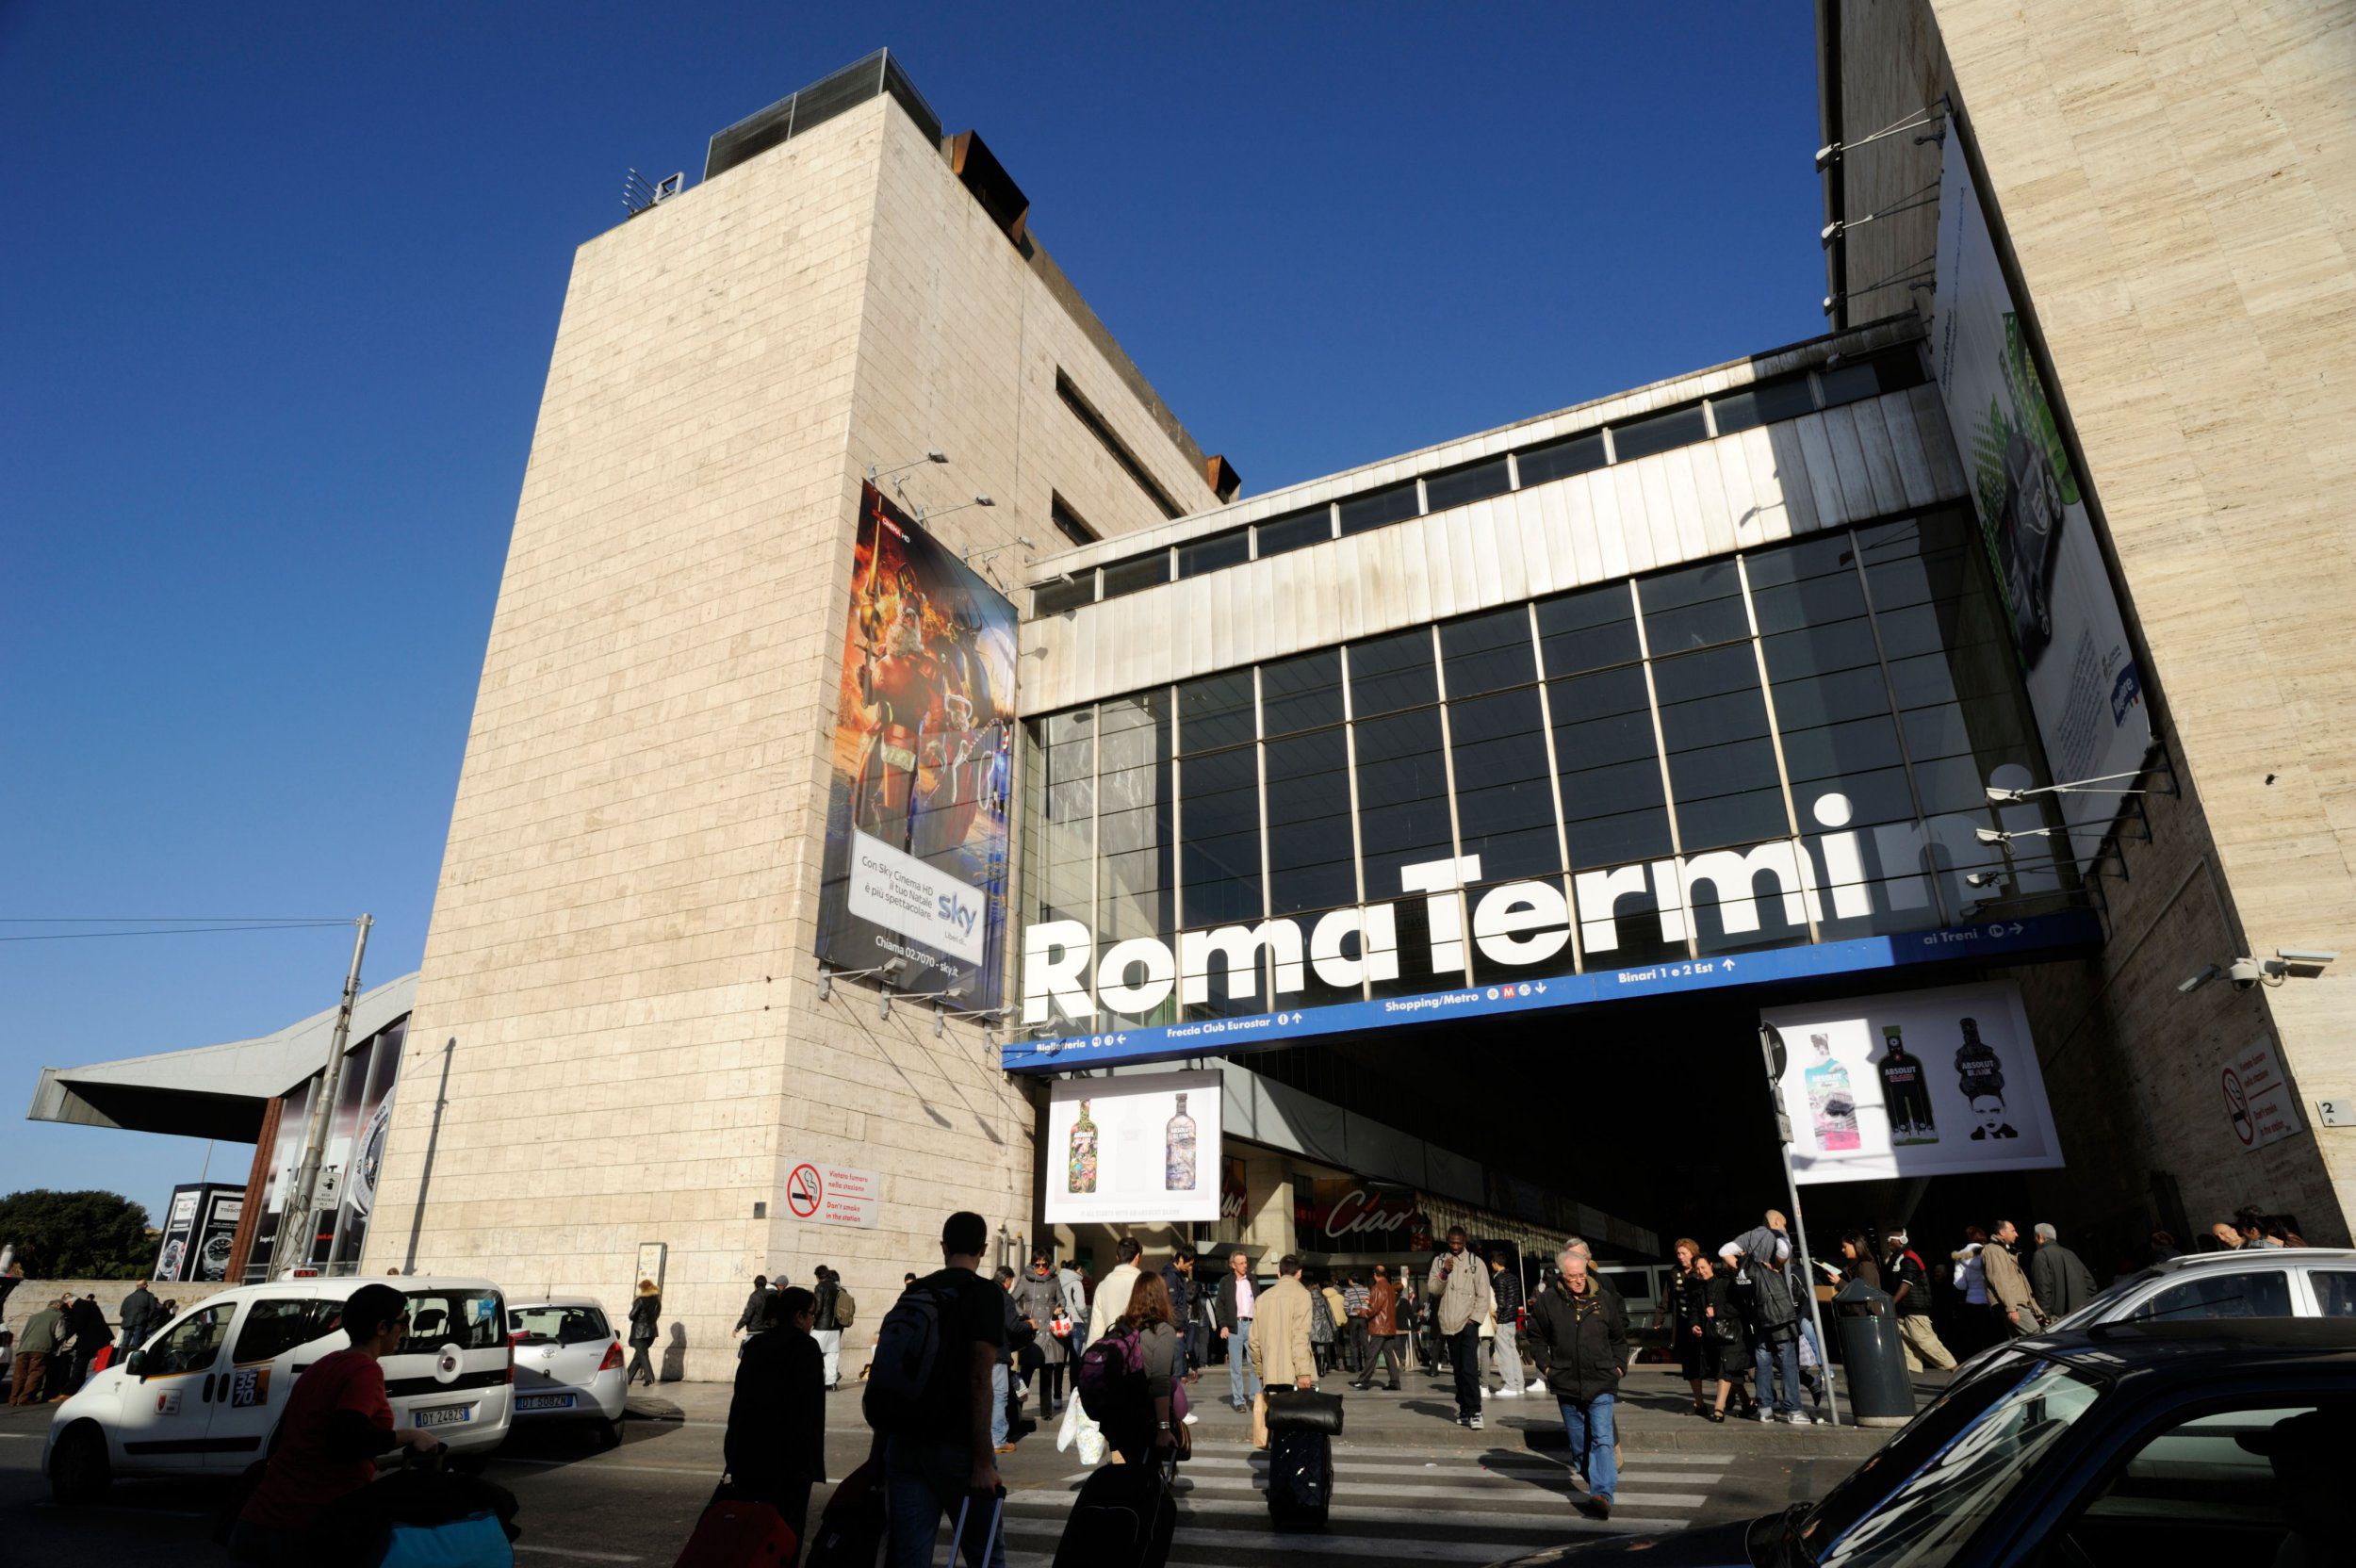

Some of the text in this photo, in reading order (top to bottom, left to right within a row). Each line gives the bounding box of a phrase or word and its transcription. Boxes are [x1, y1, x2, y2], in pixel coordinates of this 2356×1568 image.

[862, 856, 934, 896] Con Sky Cinema HD
[865, 883, 871, 893] è
[872, 886, 885, 899] più
[895, 885, 908, 897] tuo
[909, 891, 933, 909] Natale
[939, 890, 978, 939] sky
[1940, 928, 1978, 943] Treni
[875, 936, 905, 956] Chiama
[905, 947, 935, 968] 02.7070
[940, 962, 958, 977] sky.it
[1618, 963, 1713, 984] Binari 1 e 2 Est
[1385, 993, 1480, 1013] Shopping/Metro
[1167, 1018, 1271, 1038] Freccia Club Eurostar
[1885, 1066, 1916, 1076] ABSOLUT
[1962, 1060, 1994, 1070] ABSOLUT
[2322, 1102, 2334, 1113] 2
[829, 1170, 848, 1181] Vietato
[1324, 1189, 1415, 1239] Ciao
[295, 1269, 318, 1278] TAXI
[236, 1374, 257, 1389] 35
[522, 1397, 533, 1408] DT
[423, 1408, 464, 1425] DY 248ZS
